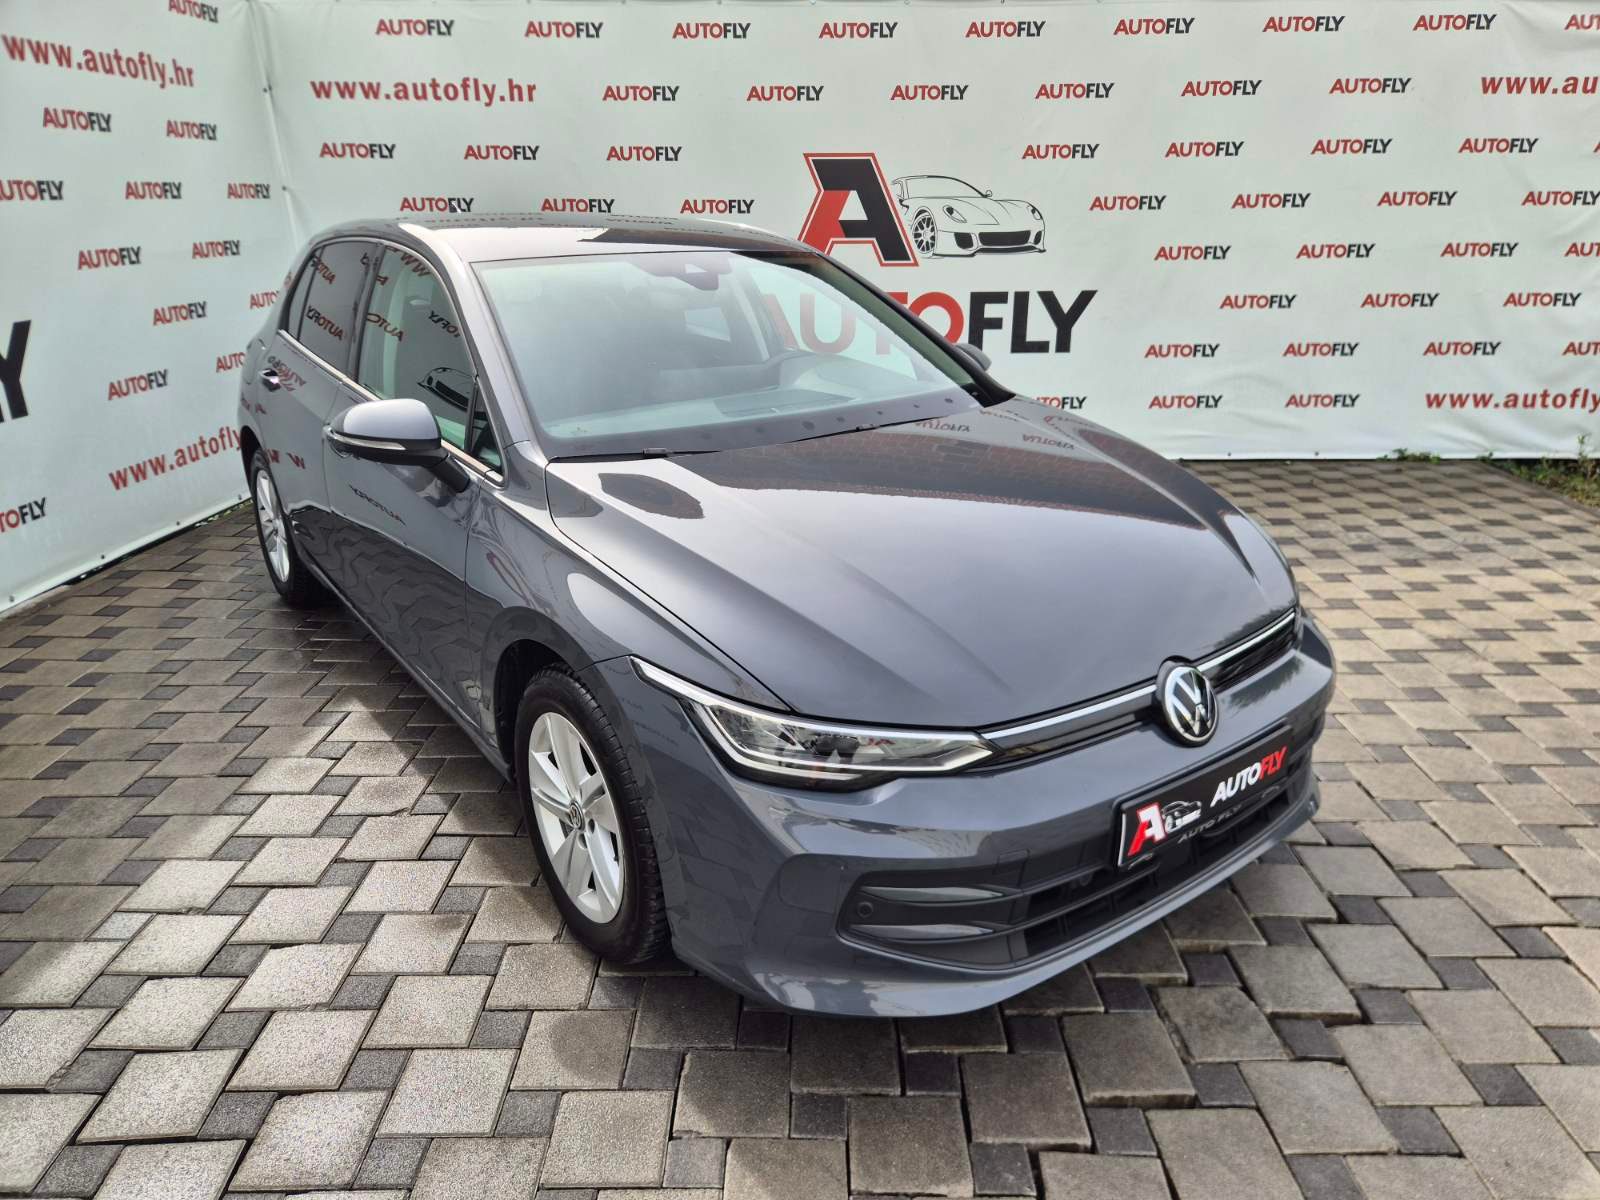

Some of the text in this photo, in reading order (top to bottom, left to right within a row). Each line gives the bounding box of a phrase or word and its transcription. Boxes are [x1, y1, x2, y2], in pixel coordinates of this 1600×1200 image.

[169, 0, 218, 23] AUTOFLY
[376, 19, 454, 36] AUTOFLY
[525, 21, 603, 38] AUTOFLY
[819, 22, 898, 39] AUTOFLY
[965, 21, 1046, 38] AUTOFLY
[1113, 18, 1195, 35] AUTOFLY
[1262, 16, 1345, 32] AUTOFLY
[1413, 14, 1497, 31] AUTOFLY
[672, 23, 751, 39] AUTOFLY
[1, 35, 193, 89] www.autofly.hr
[310, 77, 536, 107] www.autofly.hr
[602, 86, 679, 101] AUTOFLY
[747, 85, 824, 101] AUTOFLY
[890, 85, 968, 100] AUTOFLY
[1035, 83, 1115, 99] AUTOFLY
[1181, 80, 1262, 96] AUTOFLY
[1329, 78, 1412, 94] AUTOFLY
[43, 107, 111, 132] AUTOFLY
[167, 120, 216, 140] AUTOFLY
[320, 143, 396, 159] AUTOFLY
[464, 145, 539, 160] AUTOFLY
[606, 146, 682, 161] AUTOFLY
[1022, 144, 1100, 159] AUTOFLY
[1165, 141, 1244, 158] AUTOFLY
[1311, 139, 1392, 155] AUTOFLY
[1458, 138, 1539, 153] AUTOFLY
[0, 180, 63, 201] UTOFLY
[125, 182, 182, 199] AUTOFLY
[228, 183, 270, 199] AUTOFLY
[1377, 191, 1458, 206] AUTOFLY
[1521, 191, 1600, 206] AUTOFLY
[541, 198, 614, 214] AUTOFLY
[680, 199, 755, 214] AUTOFLY
[1089, 195, 1166, 211] AUTOFLY
[1231, 193, 1311, 209] AUTOFLY
[192, 240, 240, 259] AUTOFLY
[1154, 245, 1231, 261] AUTOFLY
[1296, 244, 1376, 259] AUTOFLY
[1440, 242, 1519, 257] AUTOFLY
[78, 246, 141, 270] AUTOFLY
[250, 290, 279, 309] AUTO
[1220, 294, 1297, 309] AUTOFLY
[1360, 293, 1440, 308] AUTOFLY
[1503, 292, 1582, 307] AUTOFLY
[153, 301, 206, 325] AUTOFLY
[1144, 344, 1220, 358] AUTOFLY
[1283, 342, 1359, 357] AUTOFLY
[1423, 342, 1501, 356] AUTOFLY
[108, 369, 167, 400] AUTOFLY
[1036, 396, 1087, 410] TOFLY
[1149, 395, 1223, 409] AUTOFLY
[1285, 394, 1360, 408] AUTOFLY
[1210, 746, 1288, 808] AUTOFLY
